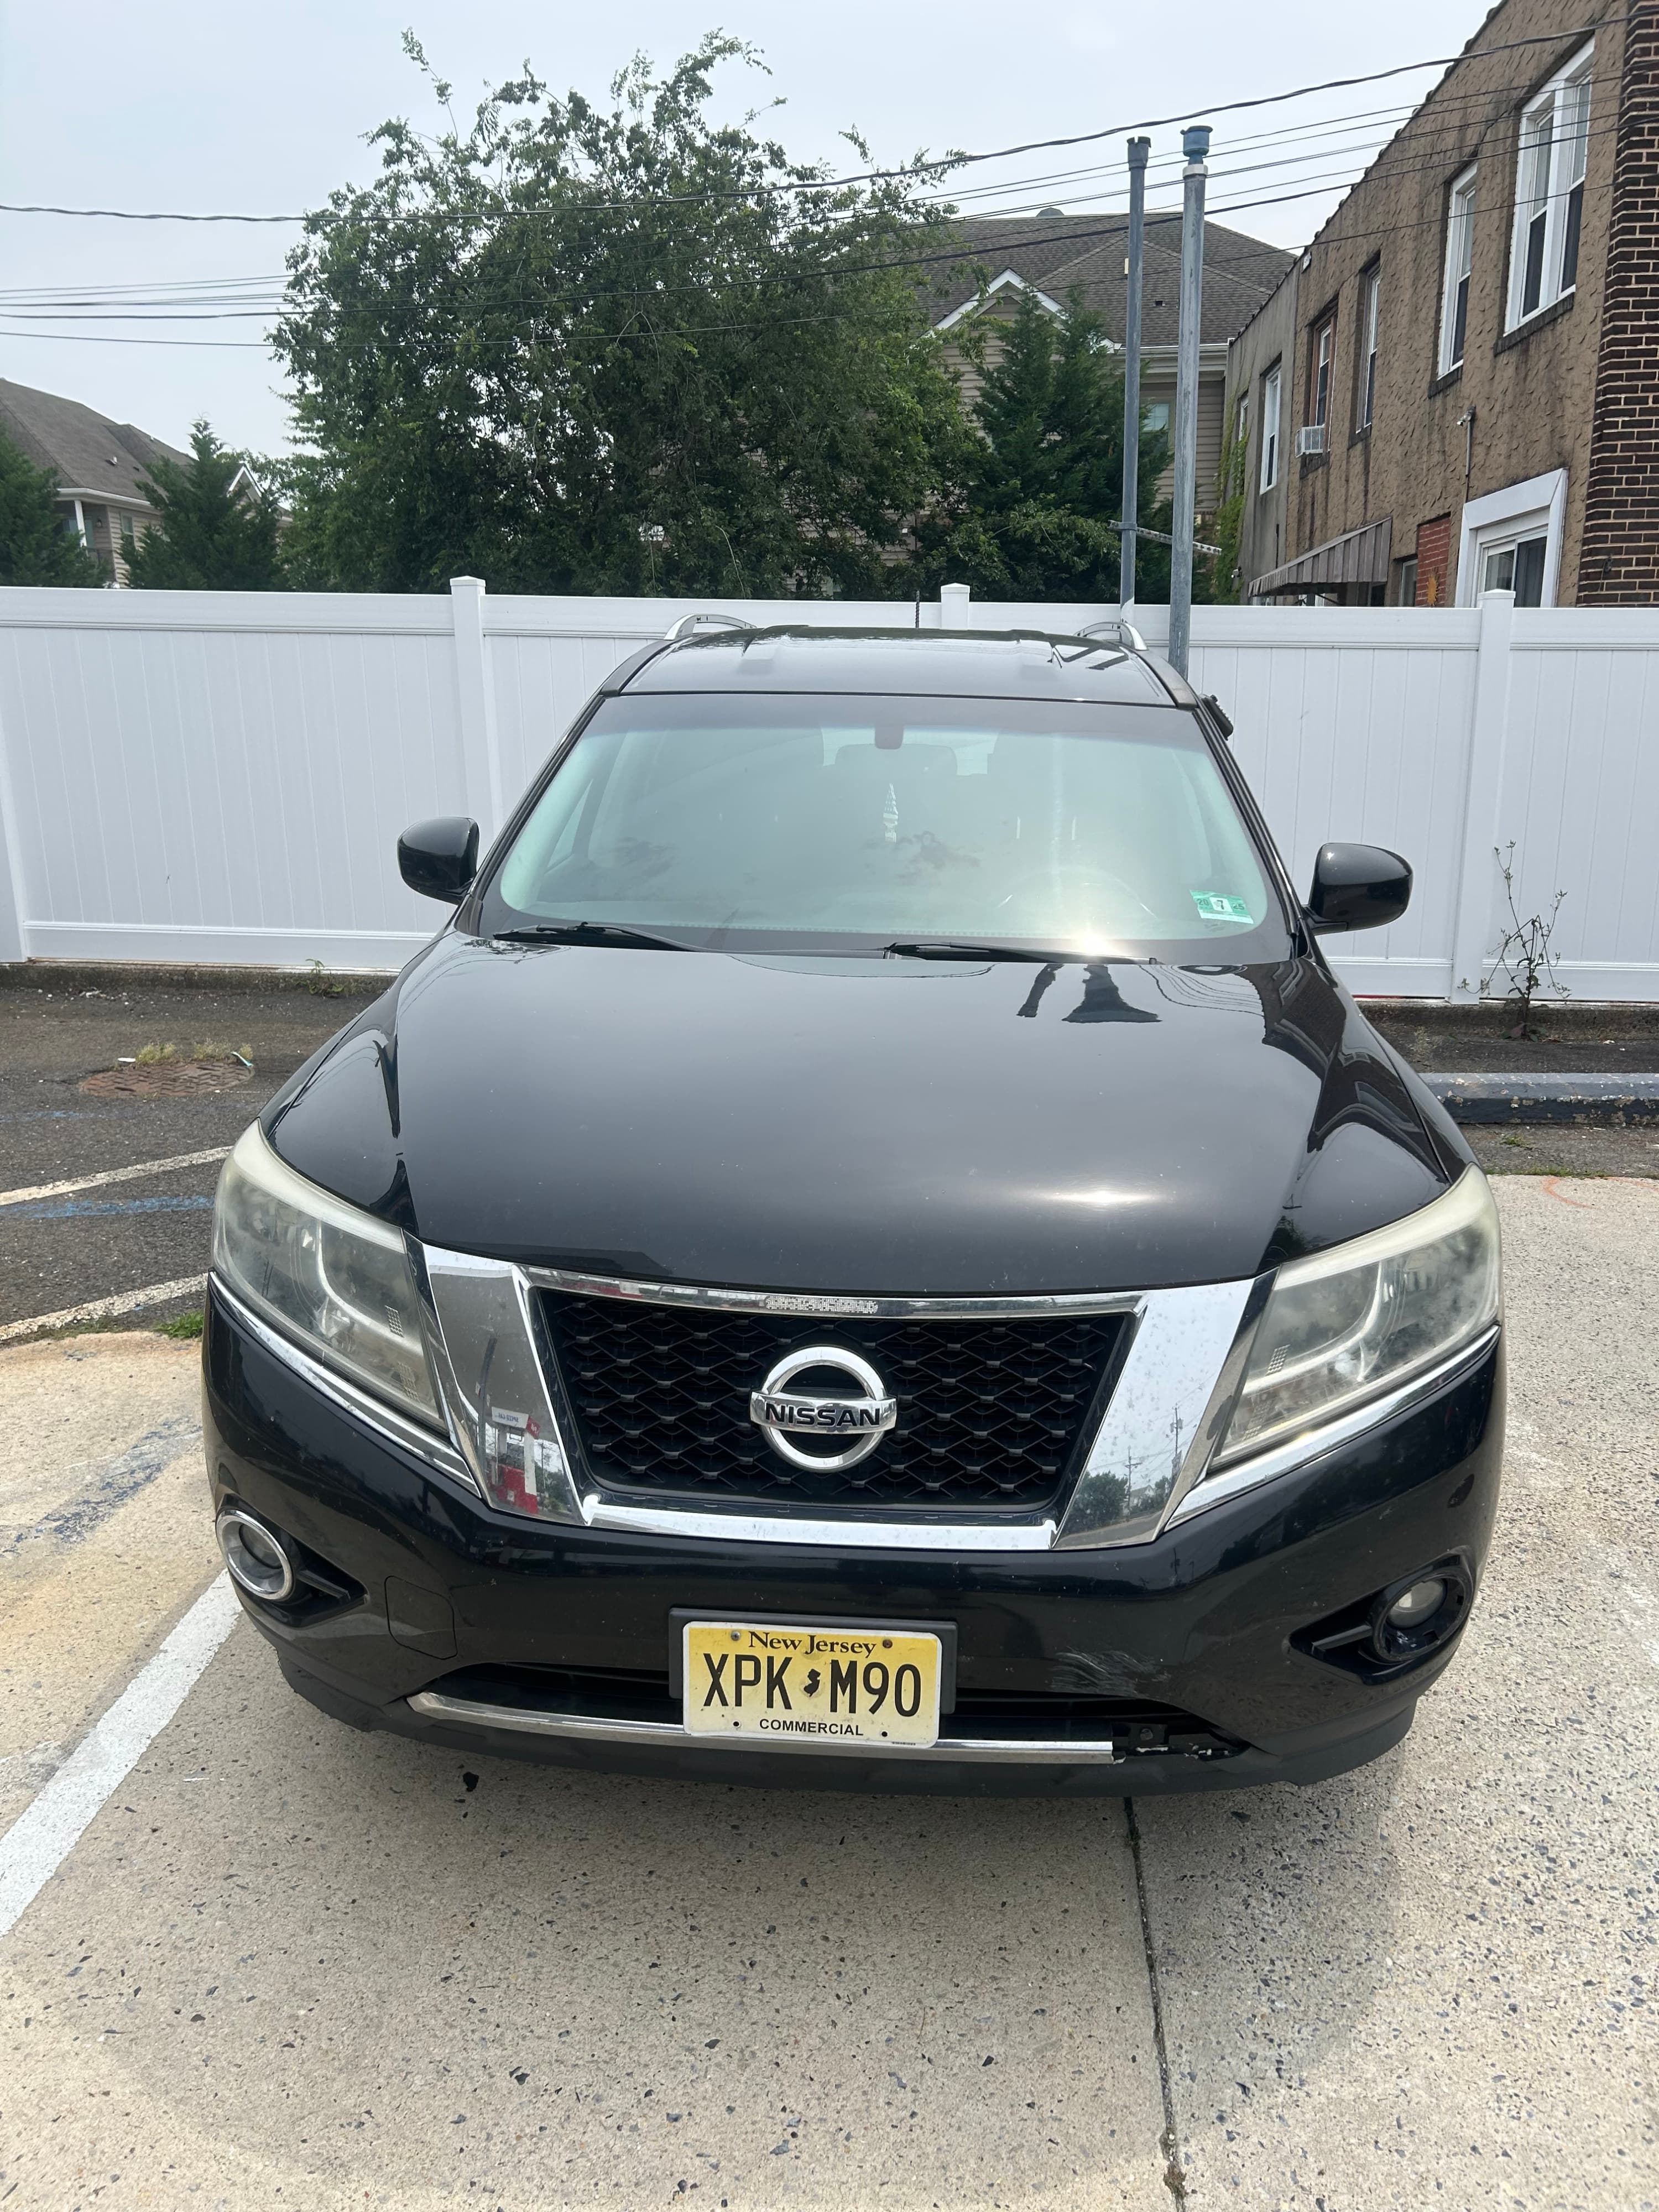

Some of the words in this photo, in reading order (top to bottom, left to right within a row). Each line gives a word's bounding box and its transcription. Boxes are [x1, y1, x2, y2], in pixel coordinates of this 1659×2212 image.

[1217, 900, 1224, 910] 7
[765, 1403, 880, 1427] NISSAN
[749, 1631, 802, 1650] New
[805, 1635, 877, 1658] Jersey
[703, 1652, 793, 1710] XPK
[830, 1659, 922, 1717] M90
[759, 1718, 864, 1736] COMMERCIAL
